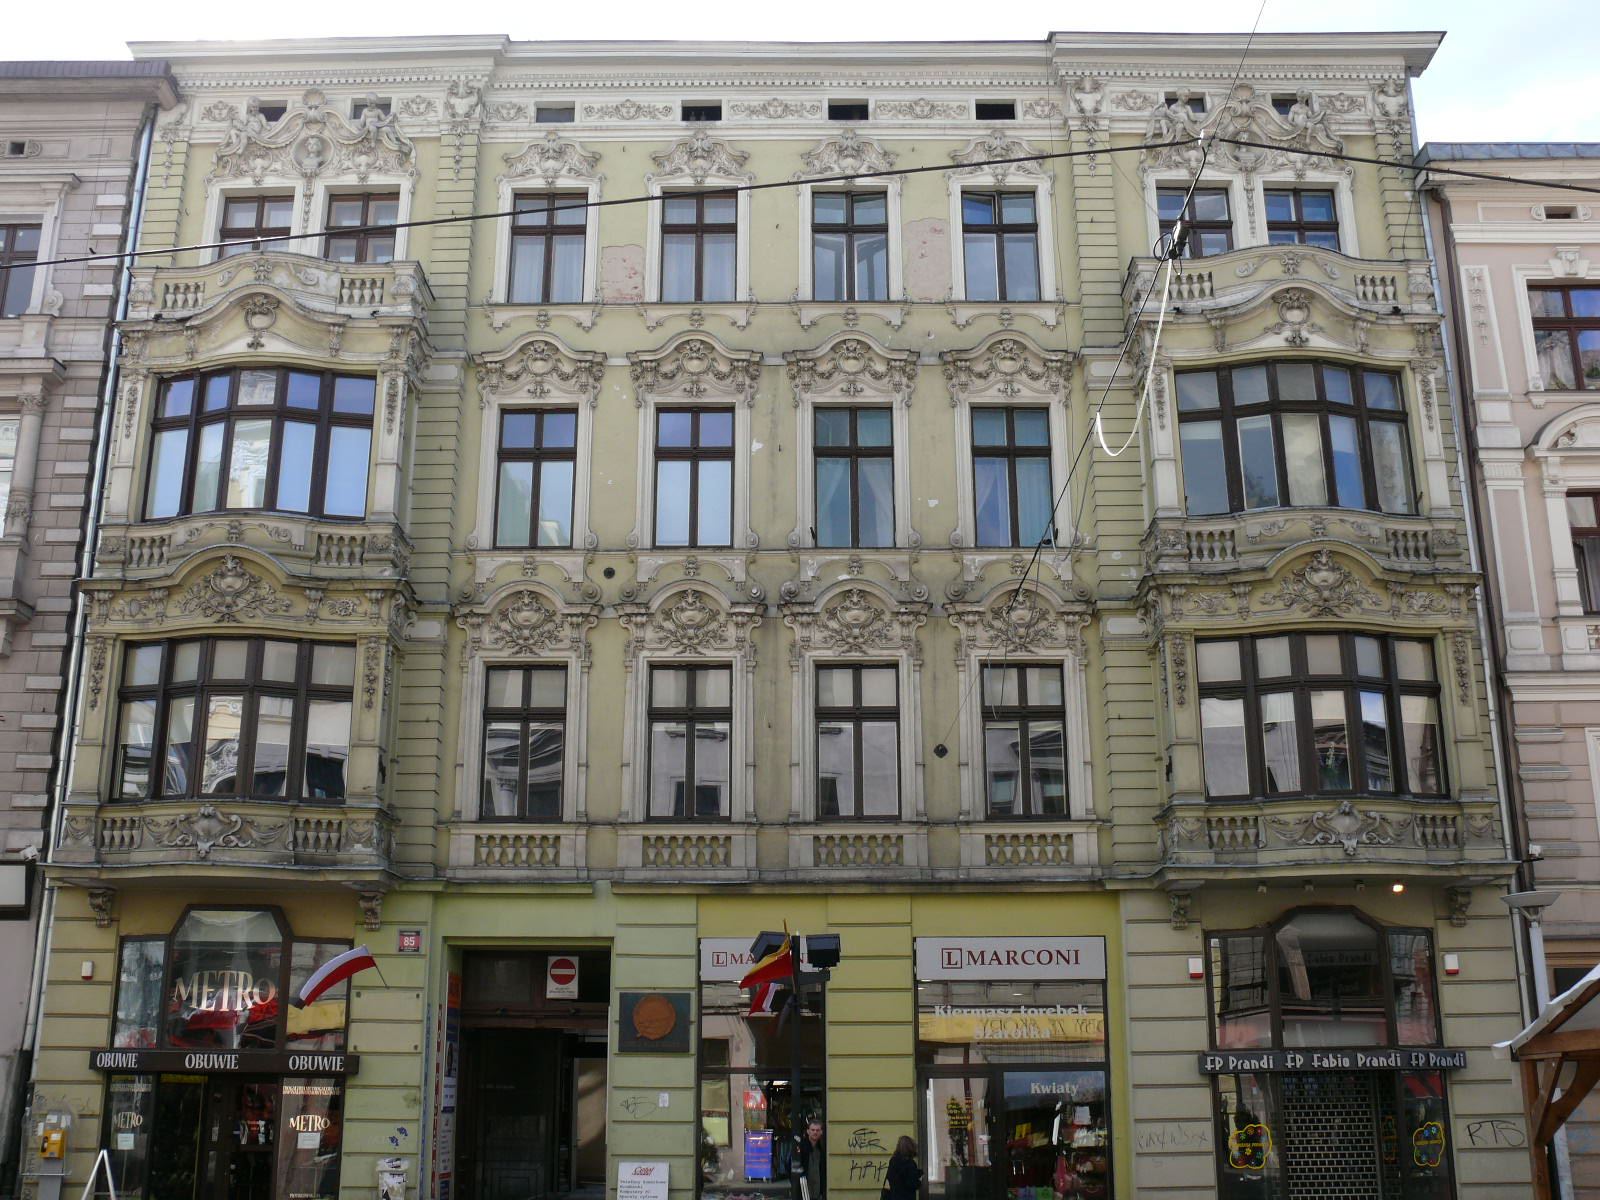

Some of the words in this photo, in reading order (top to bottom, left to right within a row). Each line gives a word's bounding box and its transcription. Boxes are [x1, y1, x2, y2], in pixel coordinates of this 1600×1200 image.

[403, 936, 415, 946] 85
[967, 949, 1081, 966] MARCONI
[172, 970, 276, 1012] METRO
[934, 1005, 1013, 1017] Kiermasz
[1020, 1003, 1088, 1017] torebek
[96, 1052, 138, 1068] OBUWIE
[184, 1053, 239, 1070] OBUWIE
[288, 1055, 345, 1072] OBUWIE
[1204, 1056, 1223, 1071] FP
[1228, 1054, 1274, 1070] Prandi
[1284, 1053, 1304, 1069] FP
[1311, 1053, 1350, 1068] Fabio
[1356, 1052, 1401, 1068] Prandi
[1410, 1052, 1426, 1065] FP
[1428, 1051, 1465, 1067] Prandi
[1030, 1082, 1080, 1096] Kwiaty
[112, 1111, 144, 1129] METRO
[288, 1114, 331, 1132] METRO
